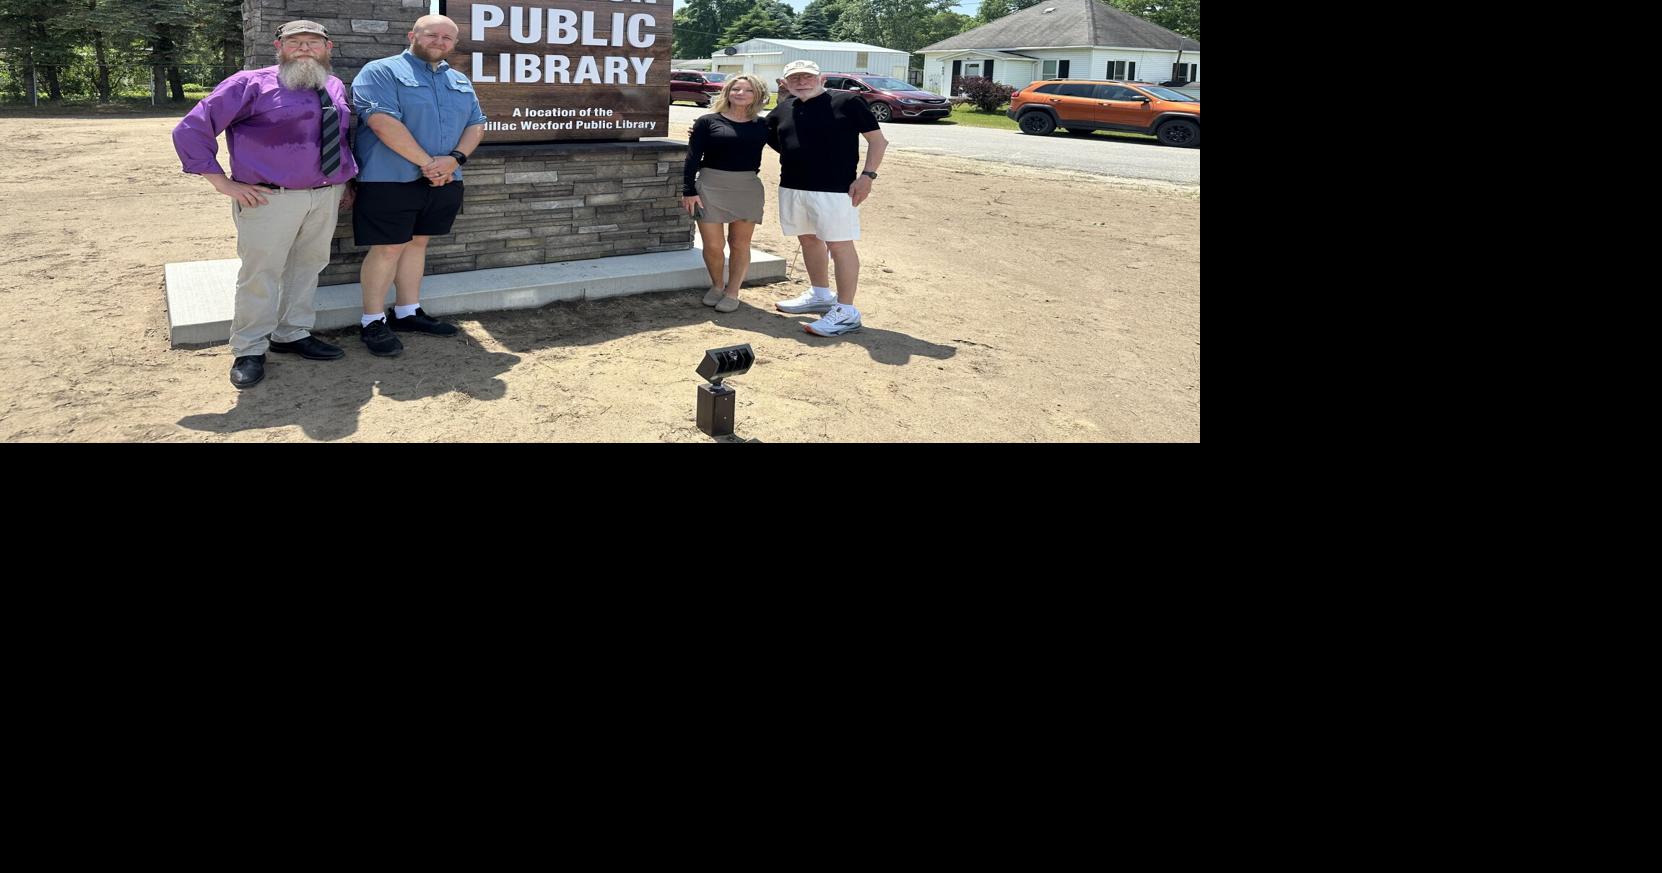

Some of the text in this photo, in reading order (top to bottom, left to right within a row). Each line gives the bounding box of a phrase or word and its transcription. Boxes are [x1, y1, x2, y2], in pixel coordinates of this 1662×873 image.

[471, 3, 656, 49] PUBLIC
[471, 52, 655, 85] LIBRARY
[512, 107, 613, 117] A location of the
[520, 120, 573, 130] Wexford
[576, 120, 613, 130] Public
[615, 119, 656, 130] Library
